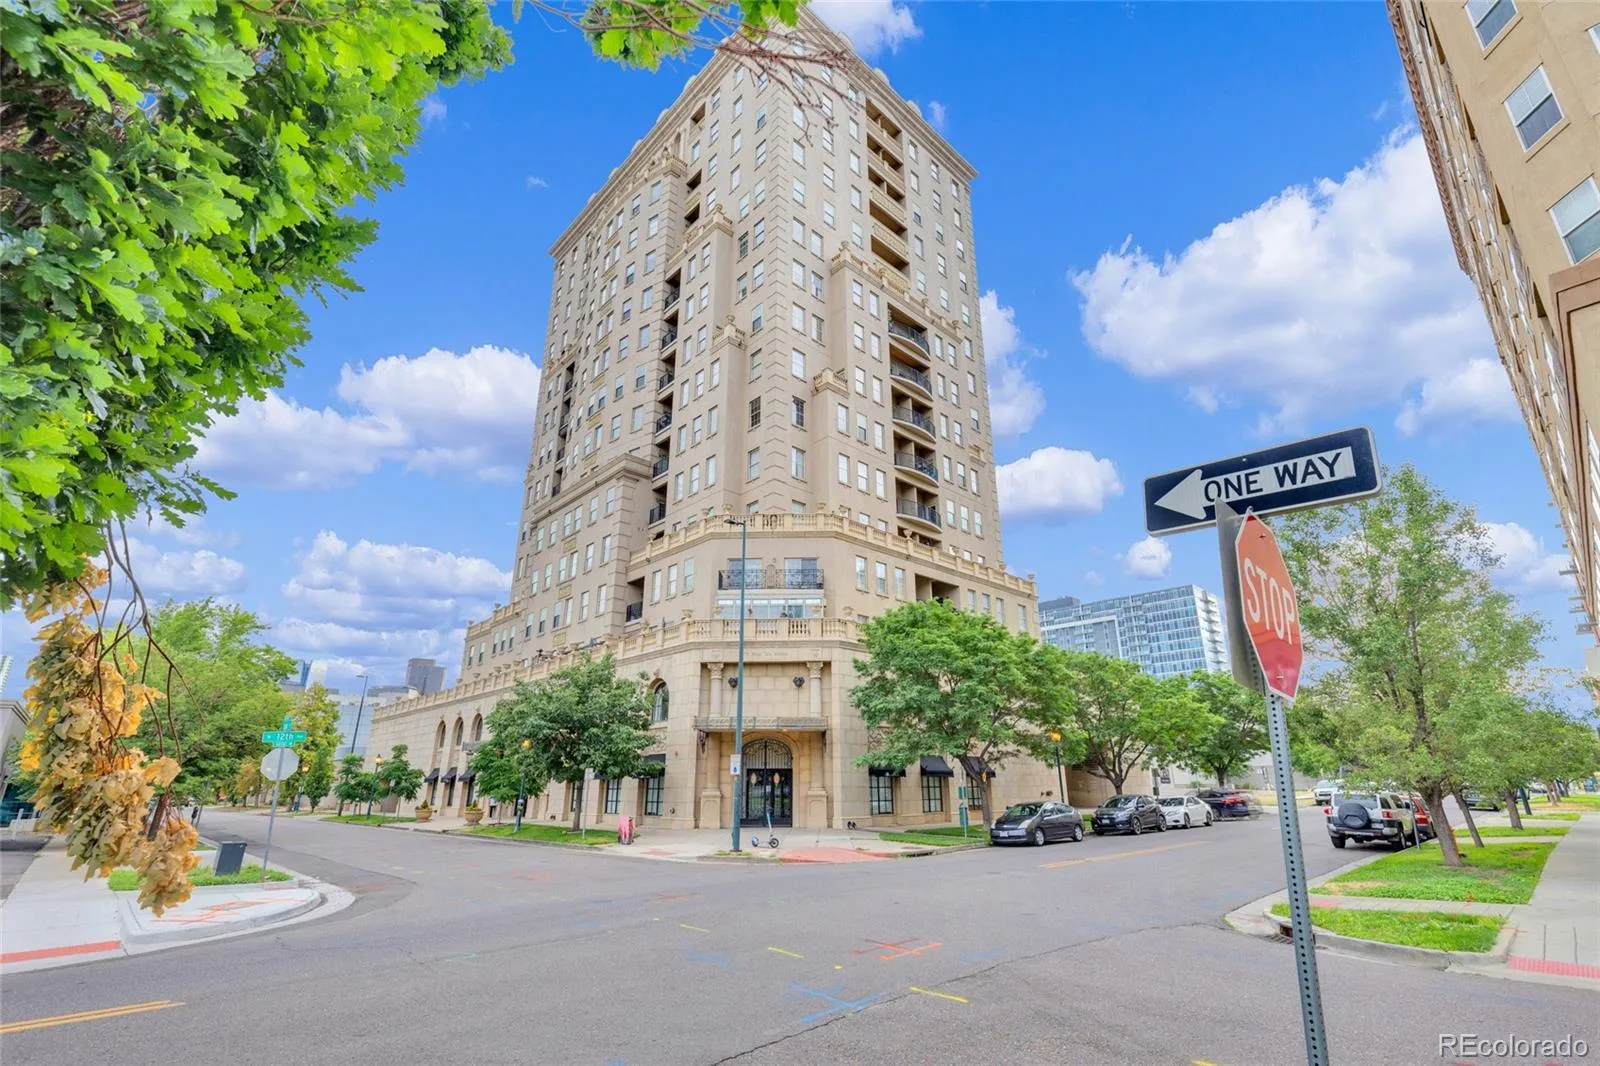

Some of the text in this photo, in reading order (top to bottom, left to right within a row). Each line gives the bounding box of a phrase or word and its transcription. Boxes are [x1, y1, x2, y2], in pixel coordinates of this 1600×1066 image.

[1204, 451, 1342, 503] ONE WAY
[1244, 557, 1295, 645] STOP
